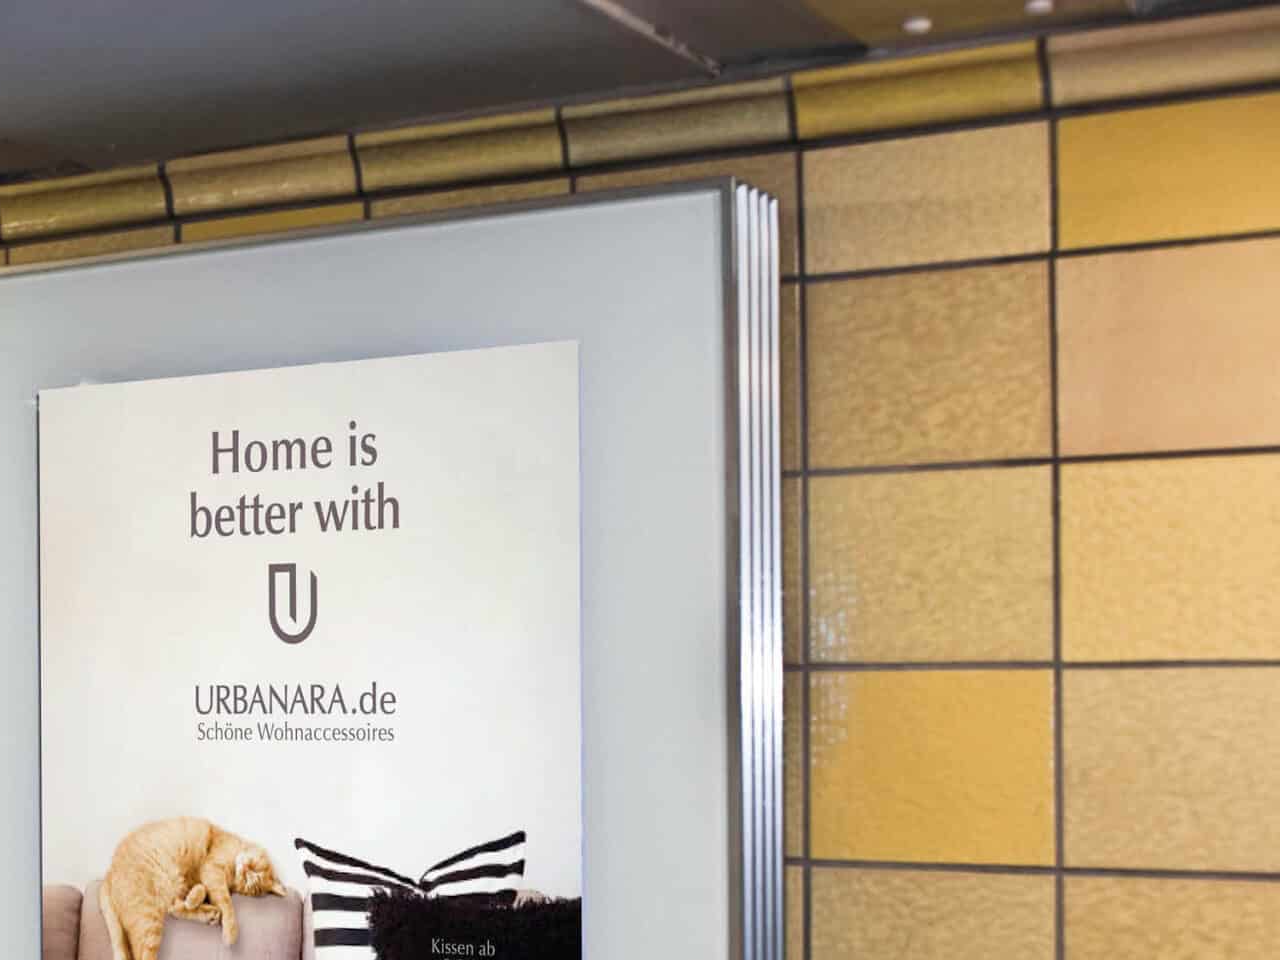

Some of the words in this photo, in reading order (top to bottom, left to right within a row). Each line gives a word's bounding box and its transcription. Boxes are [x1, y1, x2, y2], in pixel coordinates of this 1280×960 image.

[211, 430, 333, 475] Home
[349, 420, 378, 467] is
[189, 491, 303, 538] better
[314, 481, 400, 532] with
[194, 681, 397, 715] URBANARA.de
[197, 721, 253, 742] Schöne
[257, 721, 395, 742] Wohnaccessoires
[431, 937, 474, 956] Kissen
[478, 939, 496, 957] ab
